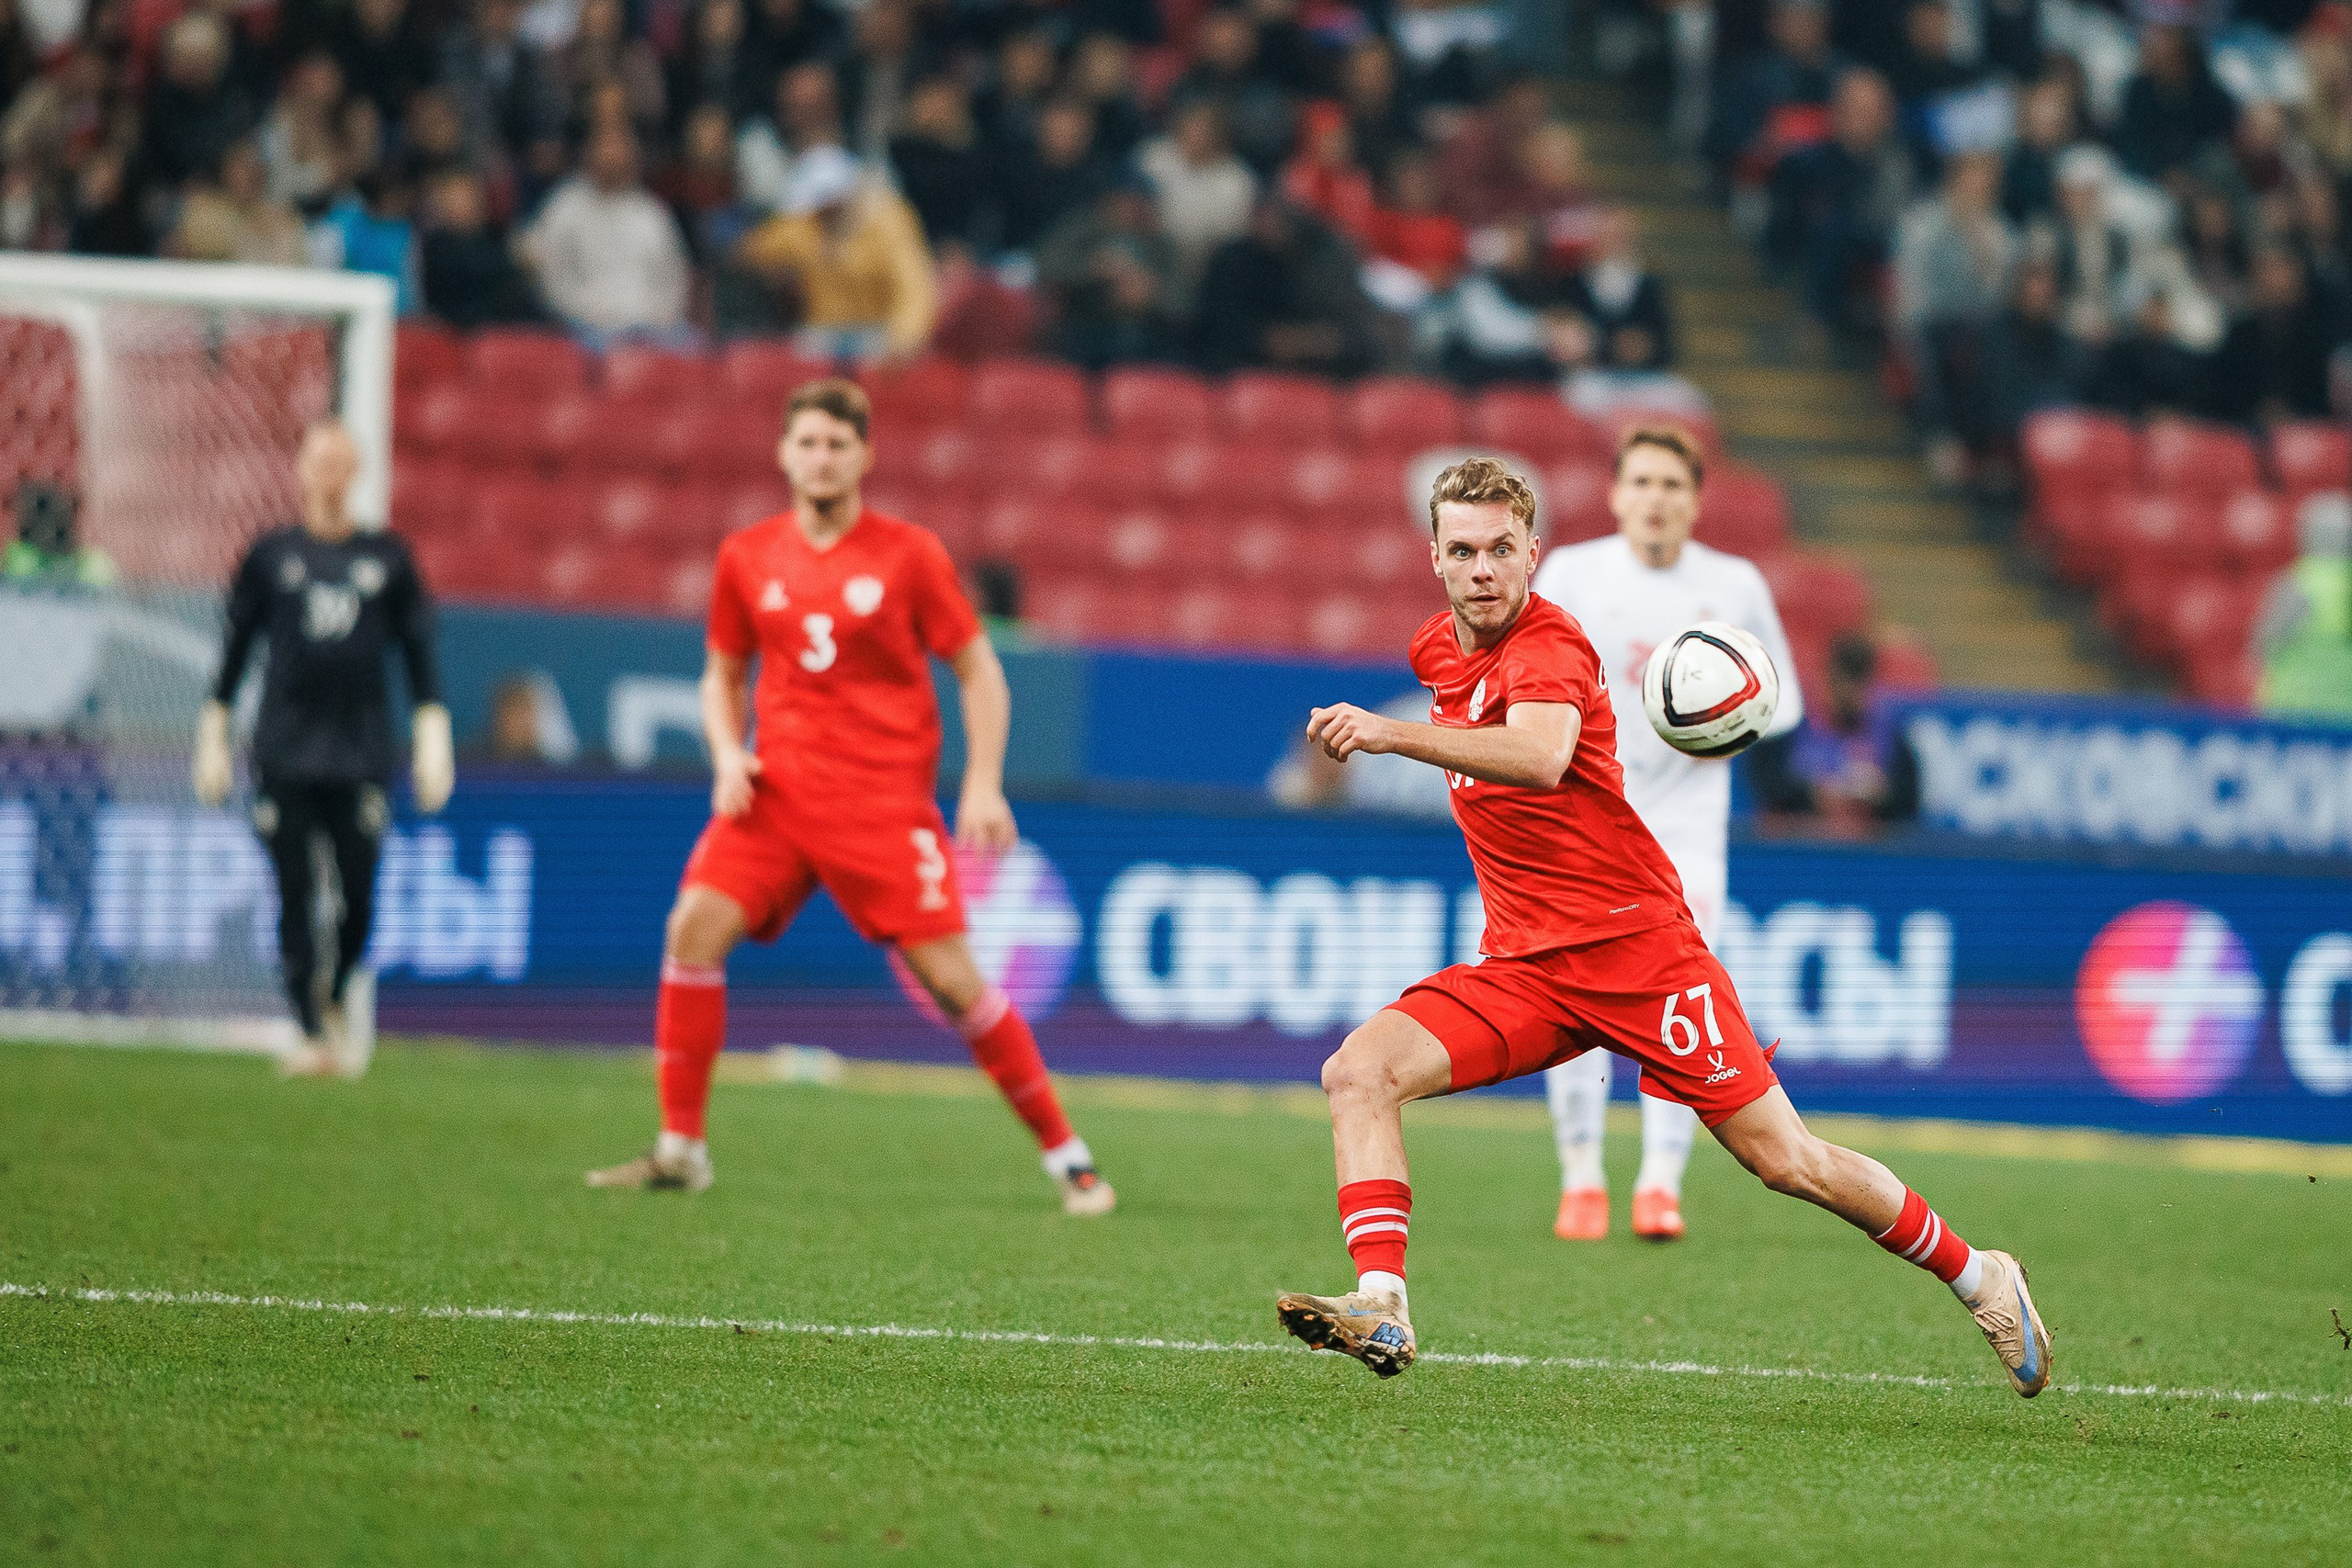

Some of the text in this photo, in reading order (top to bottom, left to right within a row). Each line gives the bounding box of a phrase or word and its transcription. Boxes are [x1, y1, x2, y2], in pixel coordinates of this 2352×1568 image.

[799, 612, 837, 673] 3
[910, 828, 947, 880] 3
[94, 801, 534, 983] ПРЫ
[1661, 982, 1724, 1056] 67
